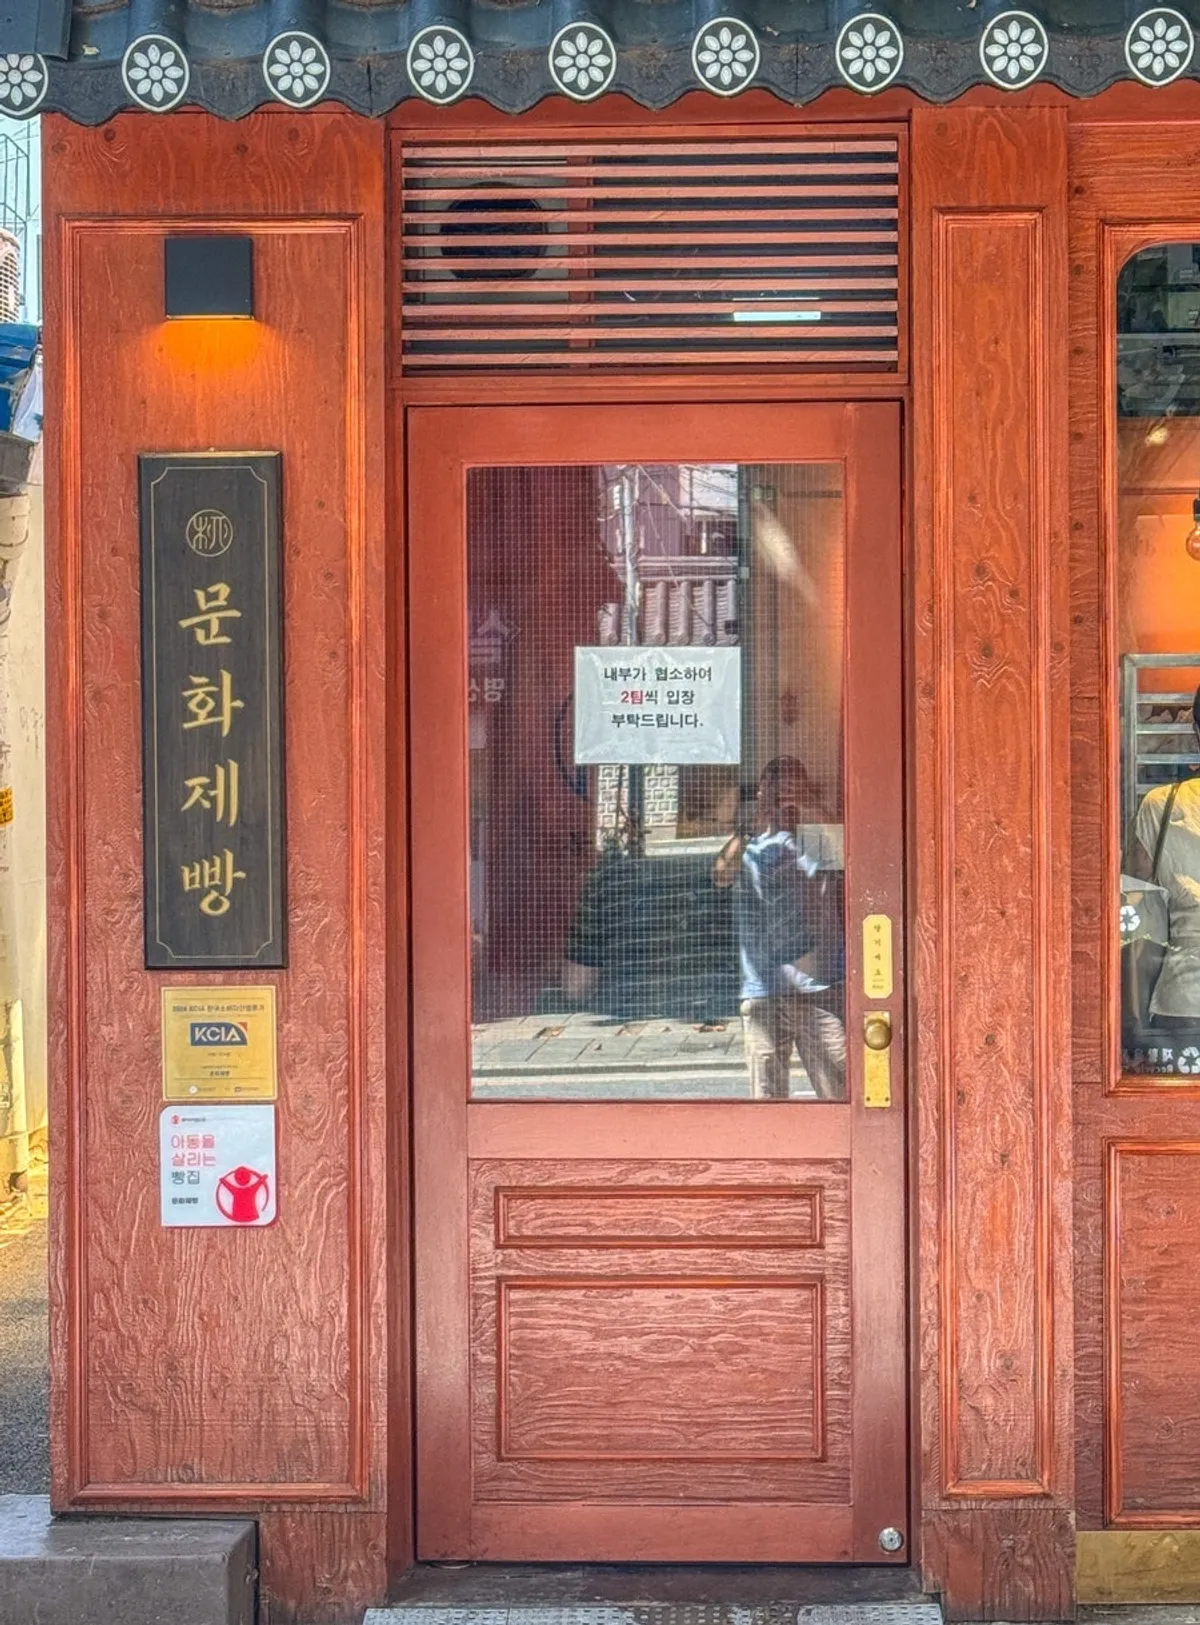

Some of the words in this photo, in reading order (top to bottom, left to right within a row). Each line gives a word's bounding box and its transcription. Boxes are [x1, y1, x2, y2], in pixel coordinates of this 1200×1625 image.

[604, 667, 646, 682] 내부가
[655, 667, 712, 682] 협소하여
[621, 690, 658, 705] 2팀씩
[667, 690, 694, 705] 입장
[612, 713, 704, 728] 부탁드립니다.
[178, 582, 247, 917] 문화제빵
[194, 1026, 241, 1042] KCIA
[171, 1134, 215, 1149] 아동을
[171, 1152, 216, 1167] 살리는
[171, 1170, 200, 1185] 빵집
